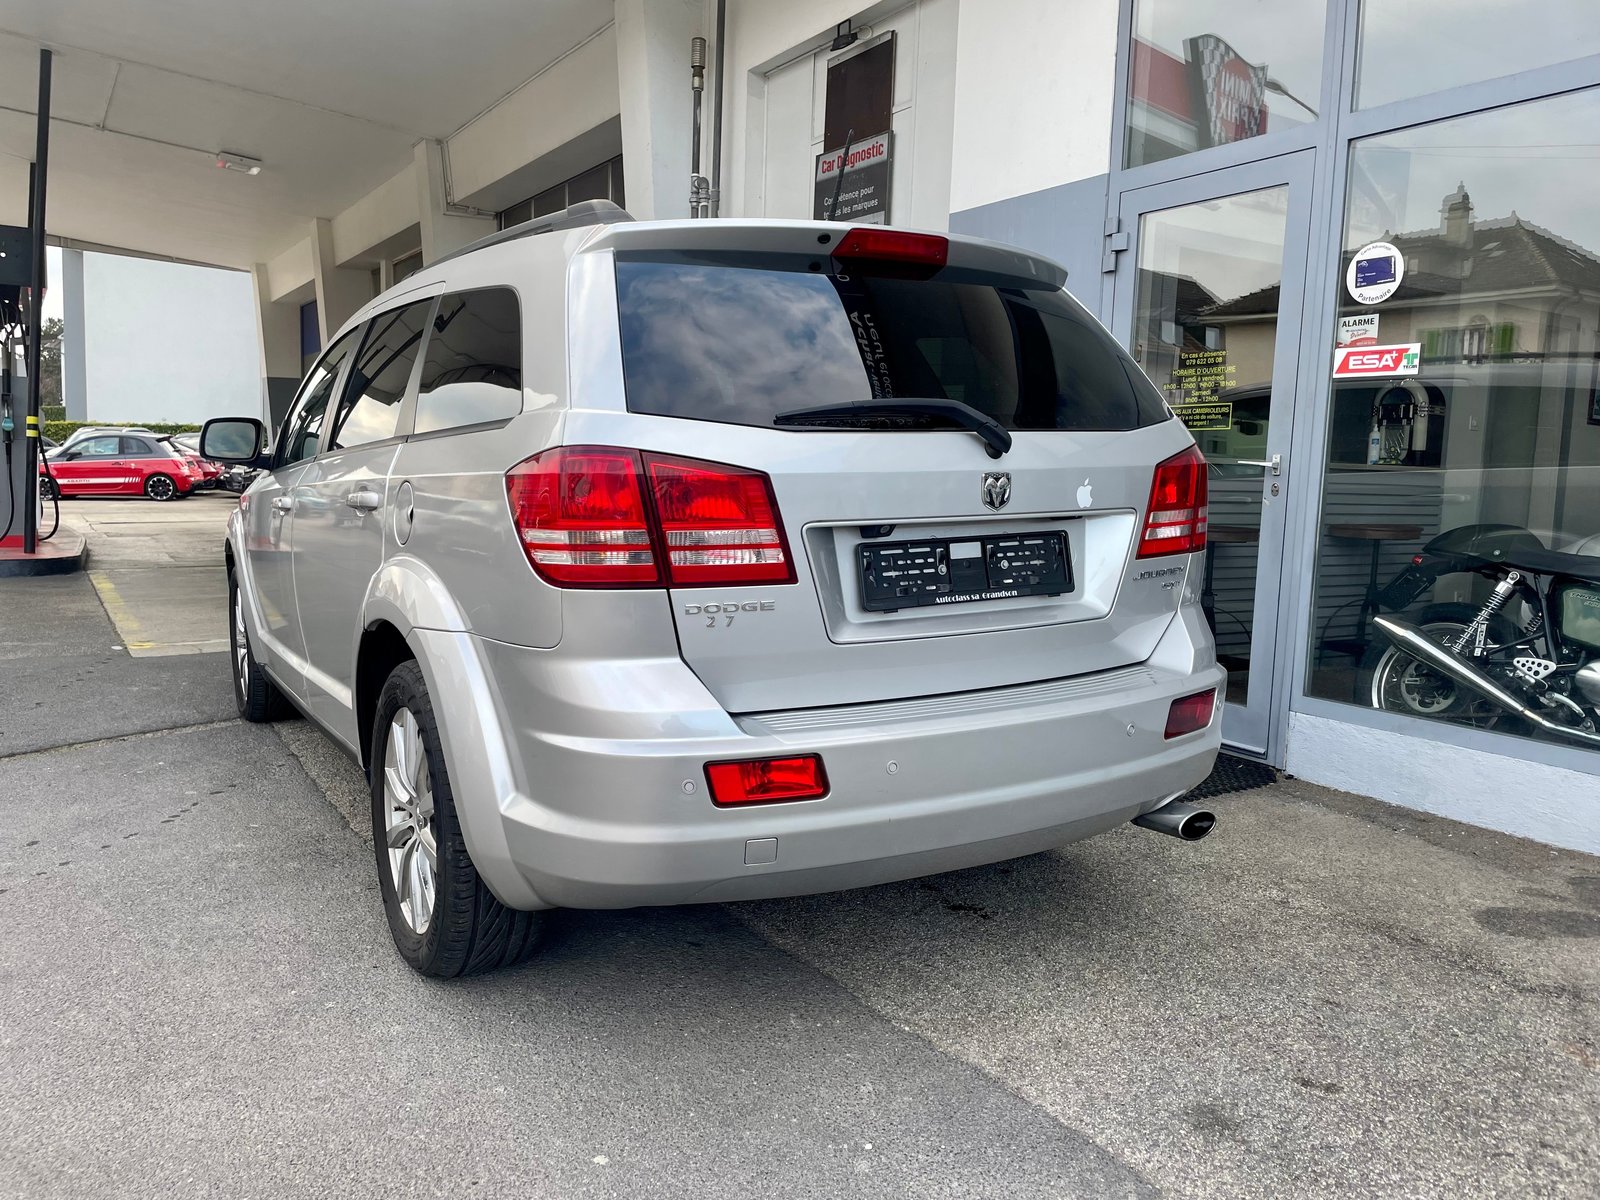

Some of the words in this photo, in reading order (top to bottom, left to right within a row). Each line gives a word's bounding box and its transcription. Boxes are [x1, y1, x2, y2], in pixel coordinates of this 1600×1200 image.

[821, 159, 835, 174] Car
[837, 141, 884, 169] Dagnostic
[824, 189, 859, 206] Coétence
[860, 185, 874, 198] pour
[842, 204, 851, 214] les
[852, 198, 878, 211] marques
[1358, 289, 1391, 302] Partenaire
[1341, 318, 1375, 328] ALARME
[1197, 366, 1236, 374] D'OUVERTURE
[1133, 566, 1184, 581] JOURNEY
[935, 594, 970, 604] Autoclass
[982, 590, 1018, 599] Grandson
[685, 600, 775, 615] DODGE
